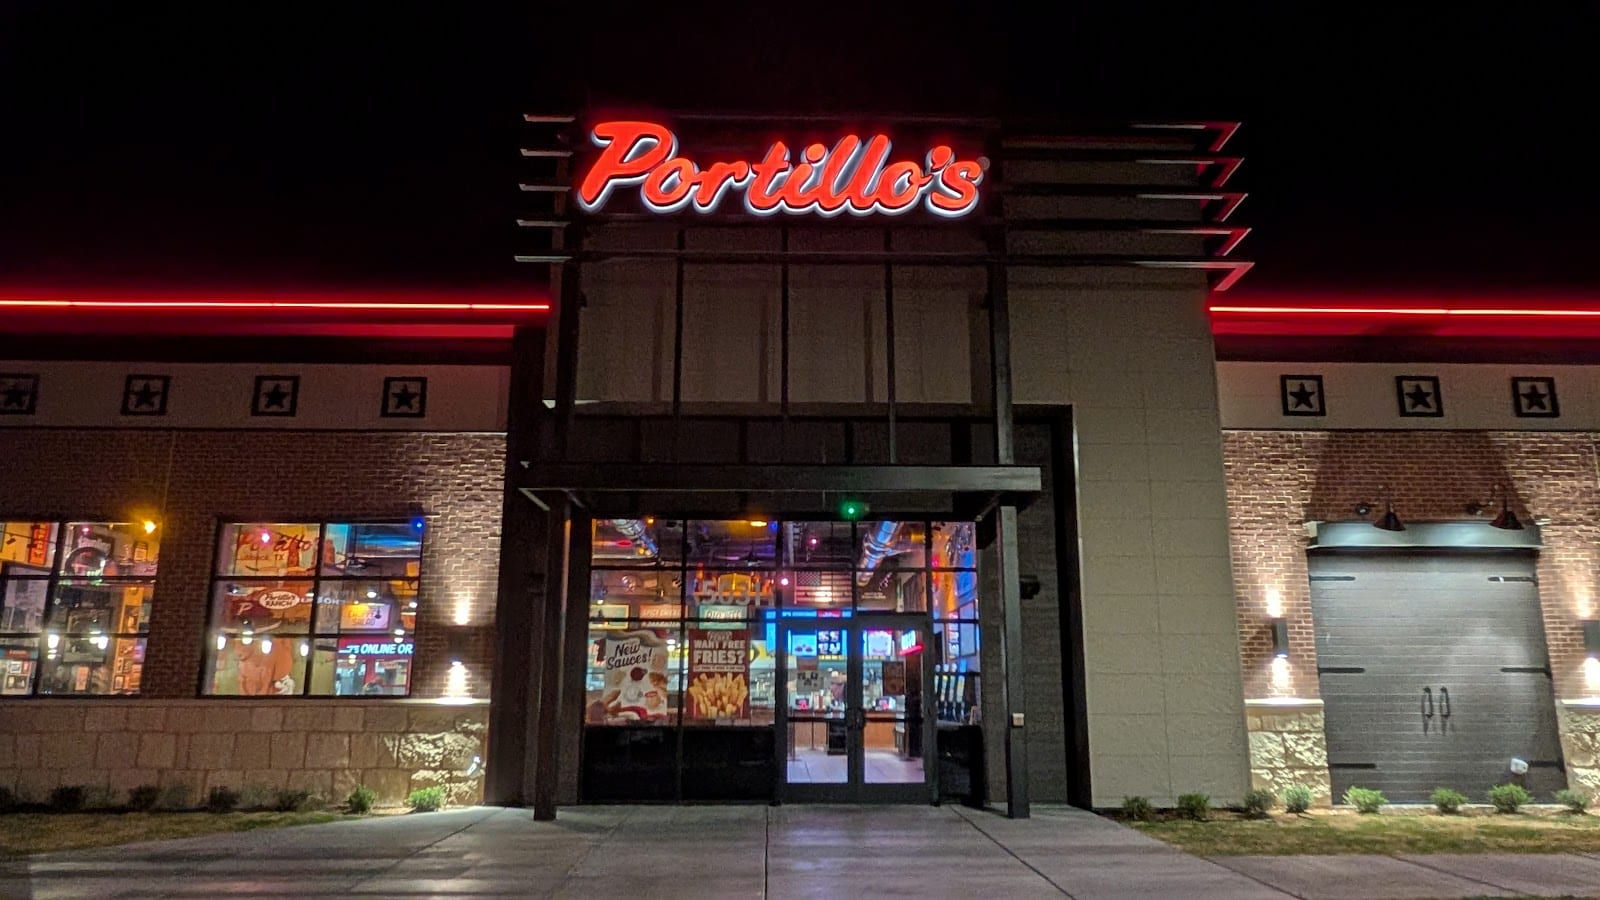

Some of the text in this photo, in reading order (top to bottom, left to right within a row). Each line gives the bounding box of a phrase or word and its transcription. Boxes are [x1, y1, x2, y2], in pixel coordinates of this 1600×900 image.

[577, 121, 983, 216] Portillo's
[360, 644, 397, 654] ONLINE
[397, 644, 414, 654] OR
[615, 643, 640, 657] New
[693, 639, 746, 649] WANT FREE
[607, 648, 652, 670] Sauces!
[693, 650, 746, 664] FRIES?
